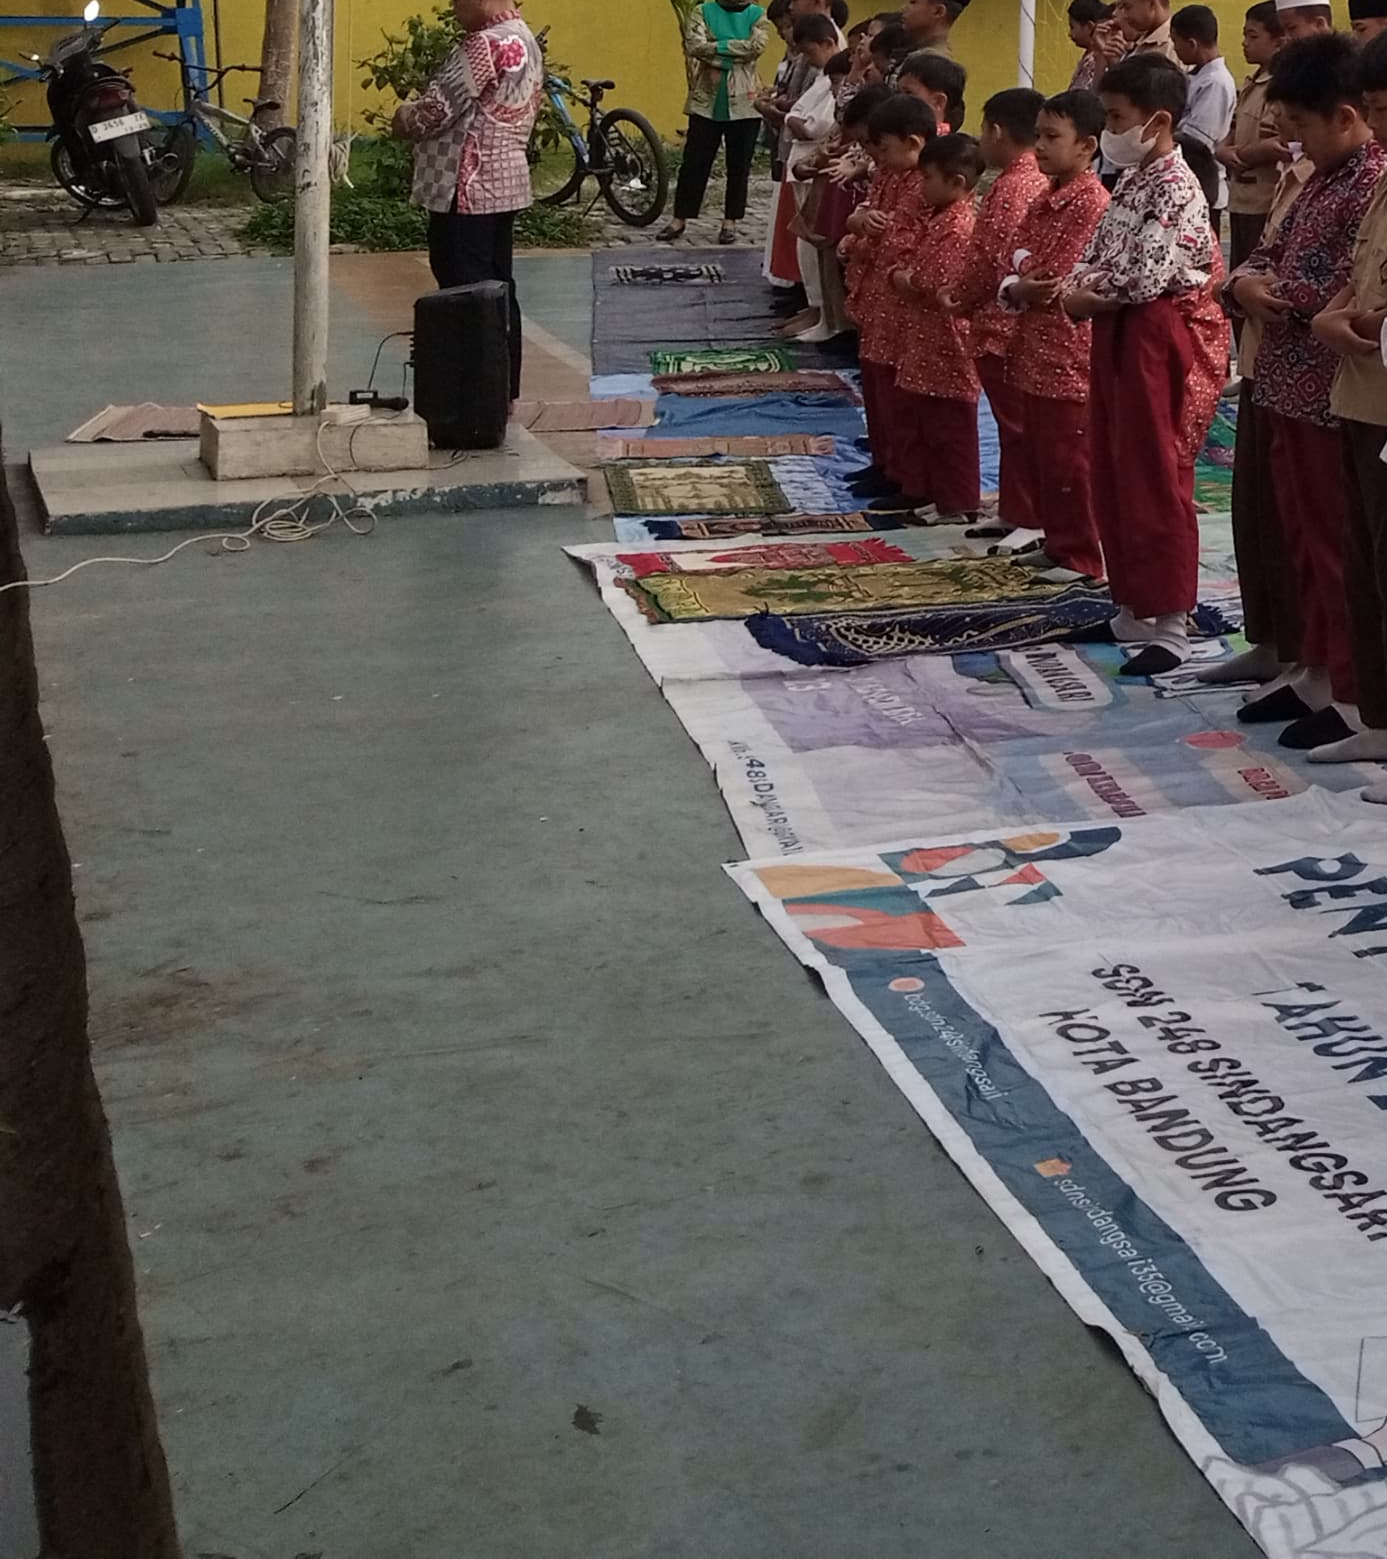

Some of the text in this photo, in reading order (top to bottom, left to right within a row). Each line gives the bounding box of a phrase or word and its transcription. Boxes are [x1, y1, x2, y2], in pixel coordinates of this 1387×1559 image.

[1091, 963, 1175, 1008] SDN
[1136, 1010, 1221, 1055] 248
[1038, 1008, 1278, 1212] KOTA BANDUNG
